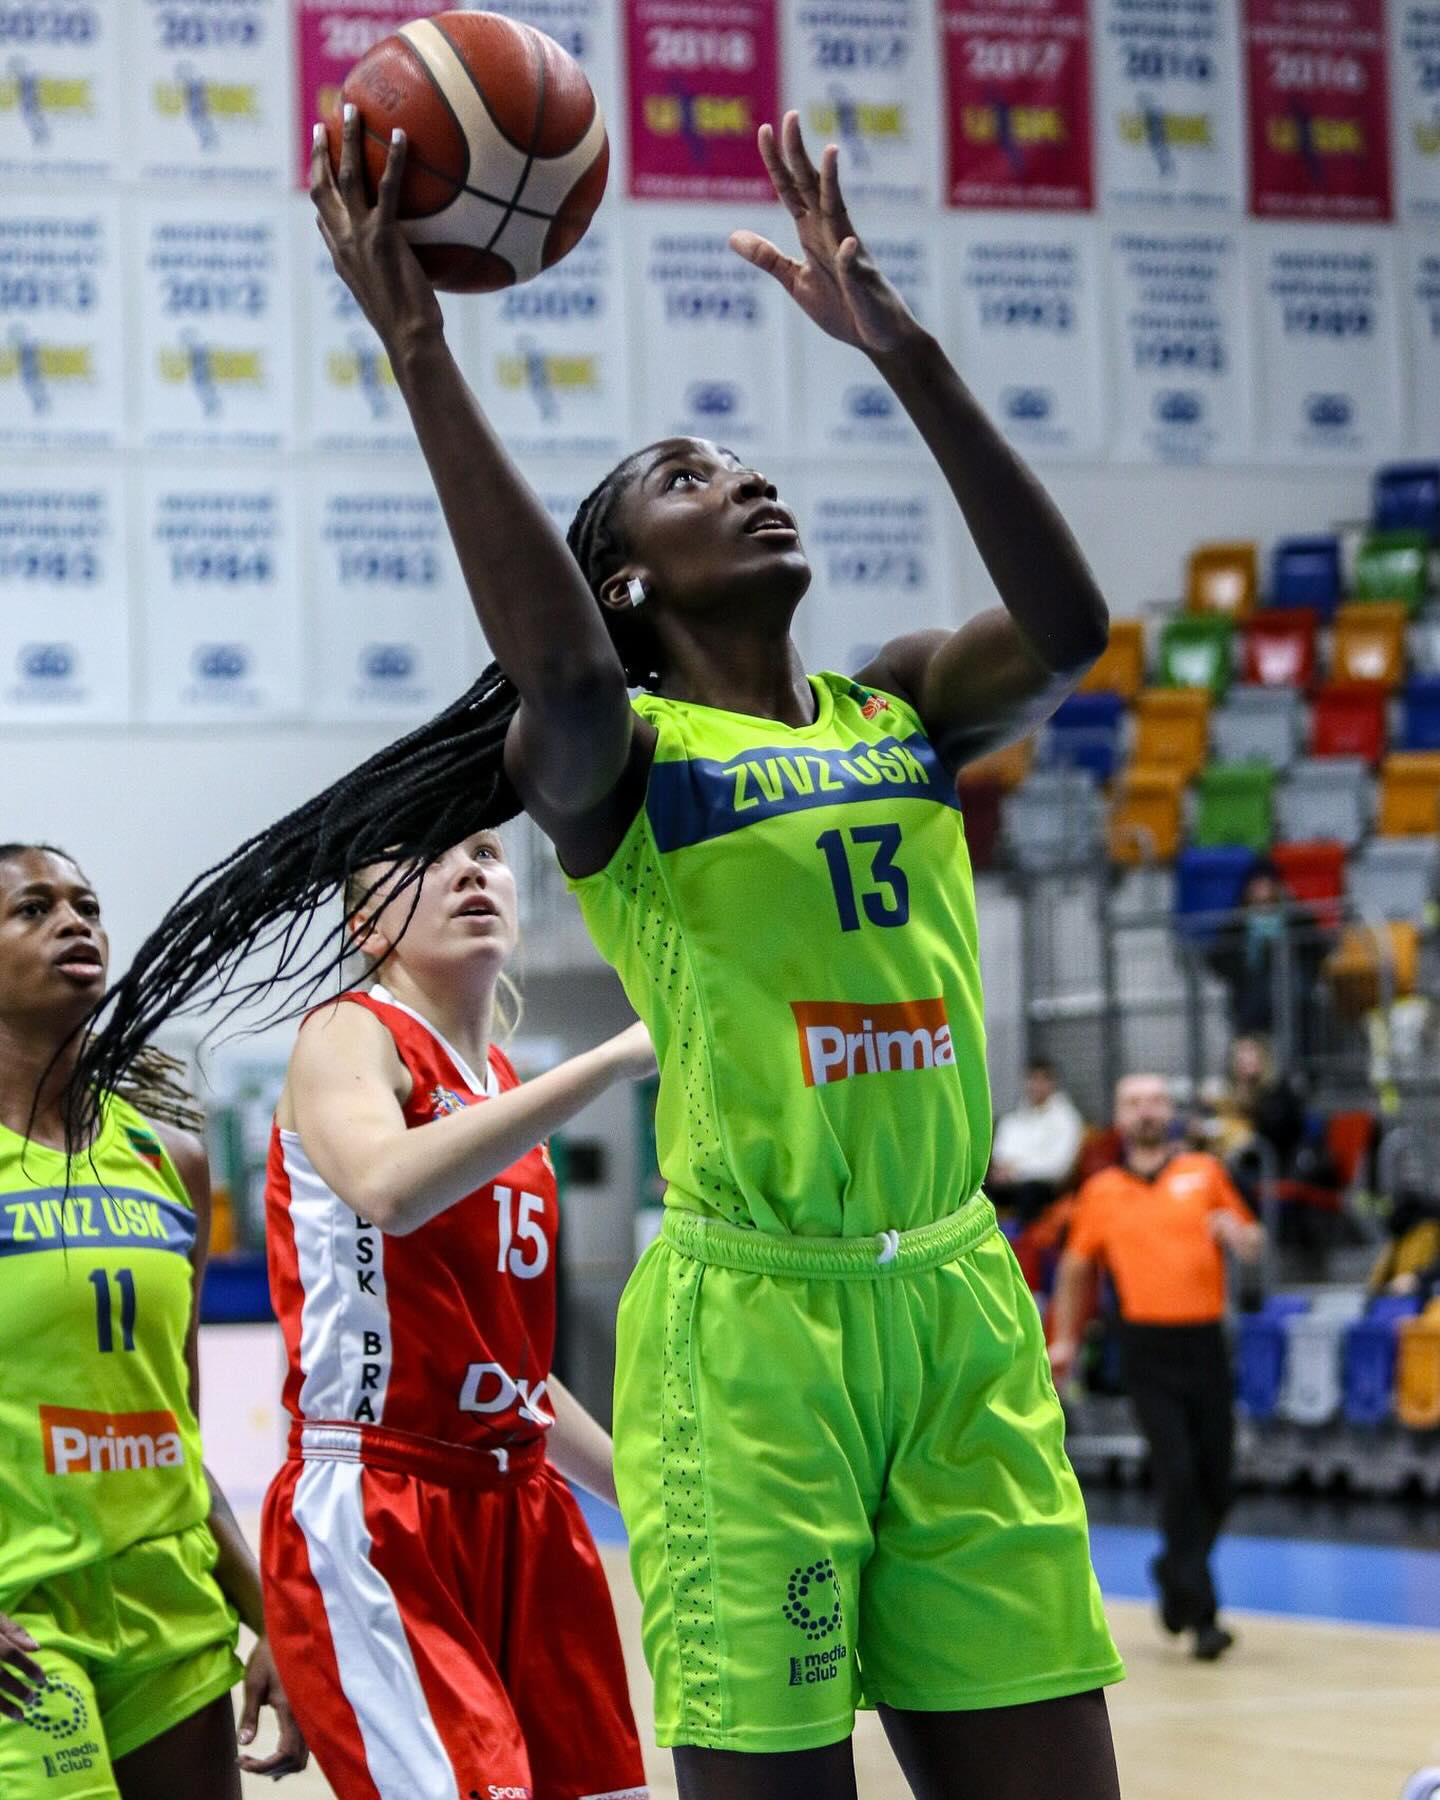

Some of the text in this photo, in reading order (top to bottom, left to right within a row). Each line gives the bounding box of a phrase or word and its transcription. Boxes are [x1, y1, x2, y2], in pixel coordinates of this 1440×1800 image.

[722, 746, 930, 812] ZVVZ USK
[816, 823, 909, 932] 13
[806, 1019, 956, 1085] Prima
[4, 1197, 169, 1242] ZVVZ USK
[493, 1185, 548, 1280] 15
[89, 1268, 136, 1352] 11
[51, 1426, 184, 1475] Prima
[805, 1644, 847, 1667] media
[805, 1664, 837, 1683] club
[56, 1741, 99, 1760] media
[60, 1759, 92, 1773] club
